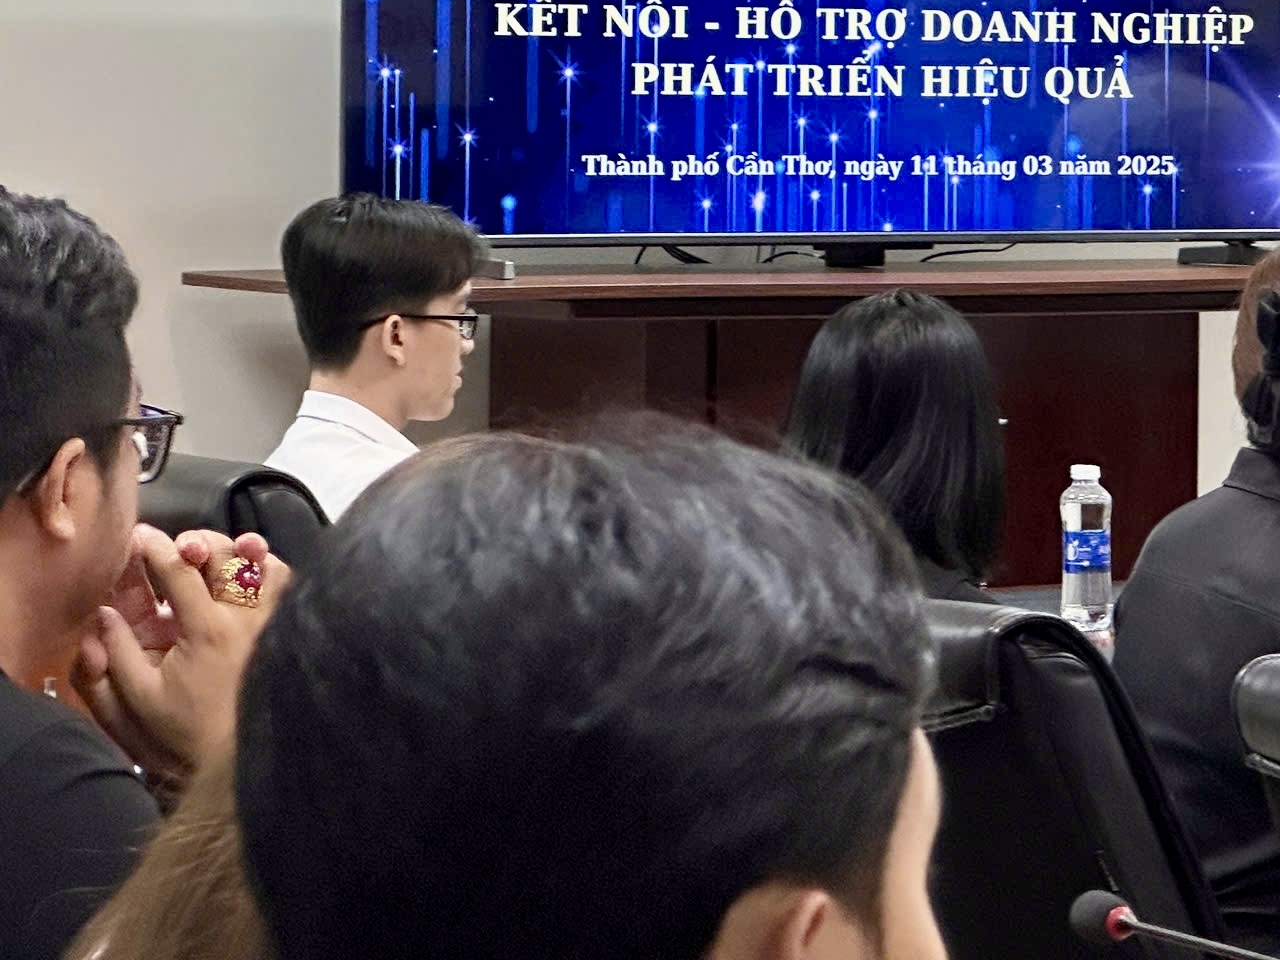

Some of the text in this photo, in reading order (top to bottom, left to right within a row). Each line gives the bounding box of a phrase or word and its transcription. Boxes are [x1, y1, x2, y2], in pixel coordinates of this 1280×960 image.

[704, 21, 720, 31] -
[817, 7, 907, 49] TRỢ
[921, 8, 1077, 43] DOANH
[1091, 6, 1254, 53] NGHIỆP
[631, 49, 1134, 106] PHÁT TRIỂN HIỆU QUẢ
[581, 151, 1175, 181] Thành phố Cần Thơ, ngày 11 tháng 03 năm 2025
